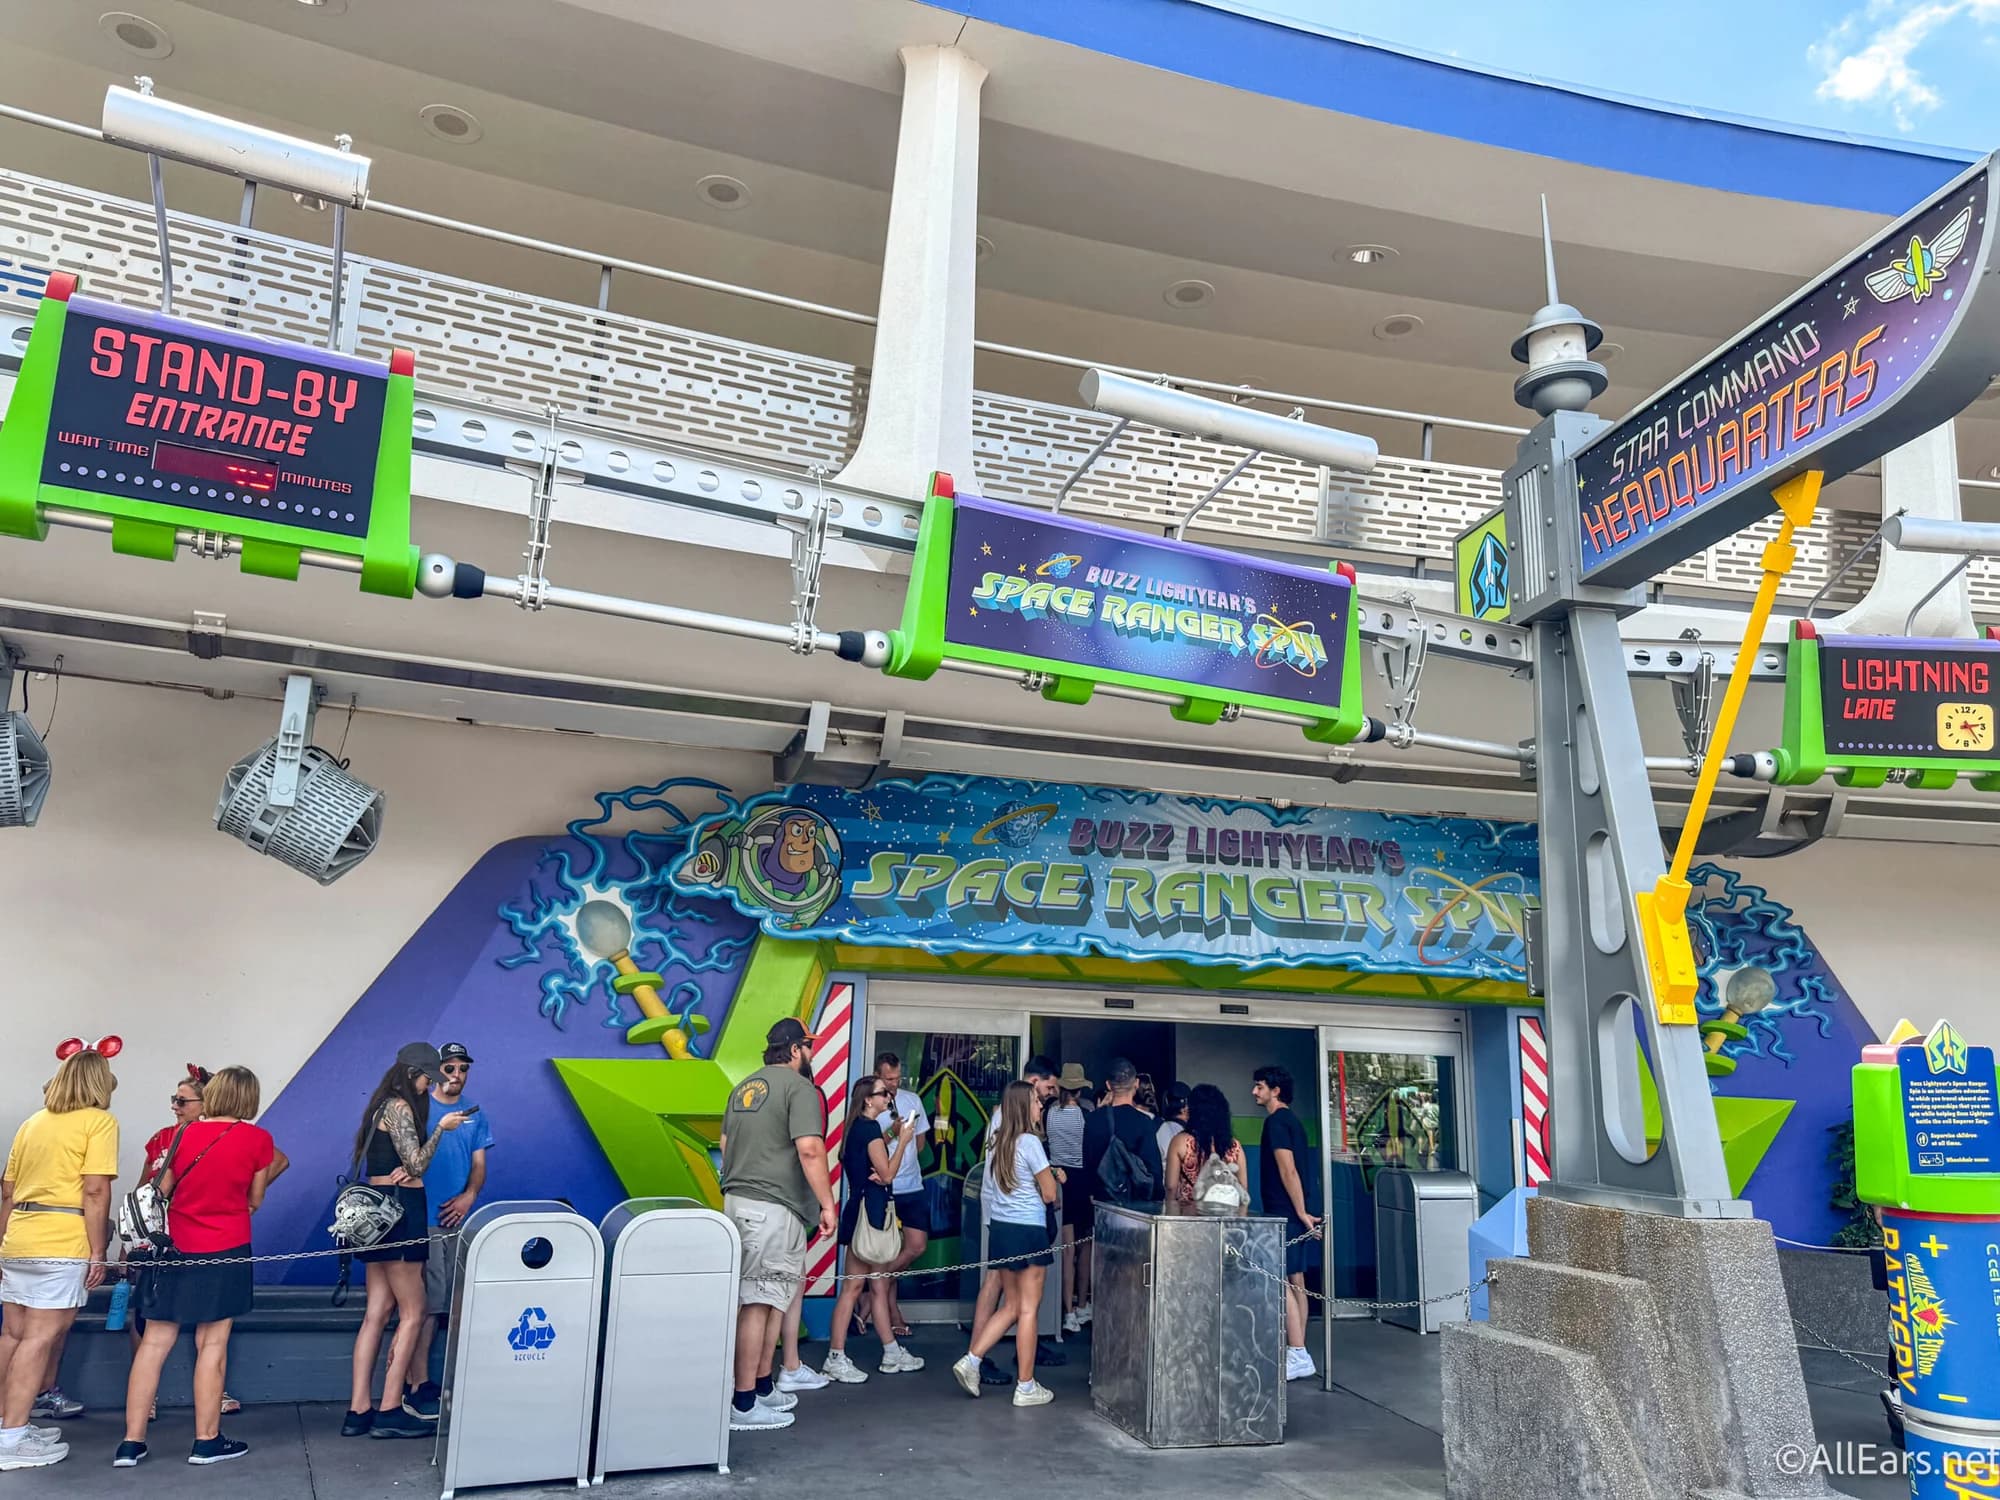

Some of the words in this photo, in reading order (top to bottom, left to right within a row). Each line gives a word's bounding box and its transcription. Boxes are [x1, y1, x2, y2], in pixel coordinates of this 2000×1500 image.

[89, 326, 358, 423] STAND-BY
[125, 392, 313, 457] ENTRANCE
[1609, 414, 1669, 485] STAR
[1676, 321, 1822, 440] COMMAND
[58, 431, 104, 449] WAIT
[105, 439, 149, 457] TIME
[1581, 323, 1887, 554] HEADQUARTERS
[280, 471, 353, 494] MINUTES
[1085, 566, 1142, 592] BUZZ
[1146, 579, 1258, 614] LIGHTYEAR'S
[972, 571, 1096, 621] SPACE
[1099, 593, 1247, 651] RANGER
[1249, 623, 1328, 666] SPIN
[1841, 658, 1990, 695] LIGHTNING
[1842, 697, 1897, 721] LANE
[1960, 706, 1971, 714] 12
[1068, 818, 1174, 857] BUZZ
[1186, 826, 1405, 873] LIGHTYEAR'S
[850, 851, 1090, 918] SPACE
[1104, 866, 1397, 940] RANGER
[1882, 1226, 1918, 1396] BATTERY
[1918, 1338, 1945, 1376] FUSION
